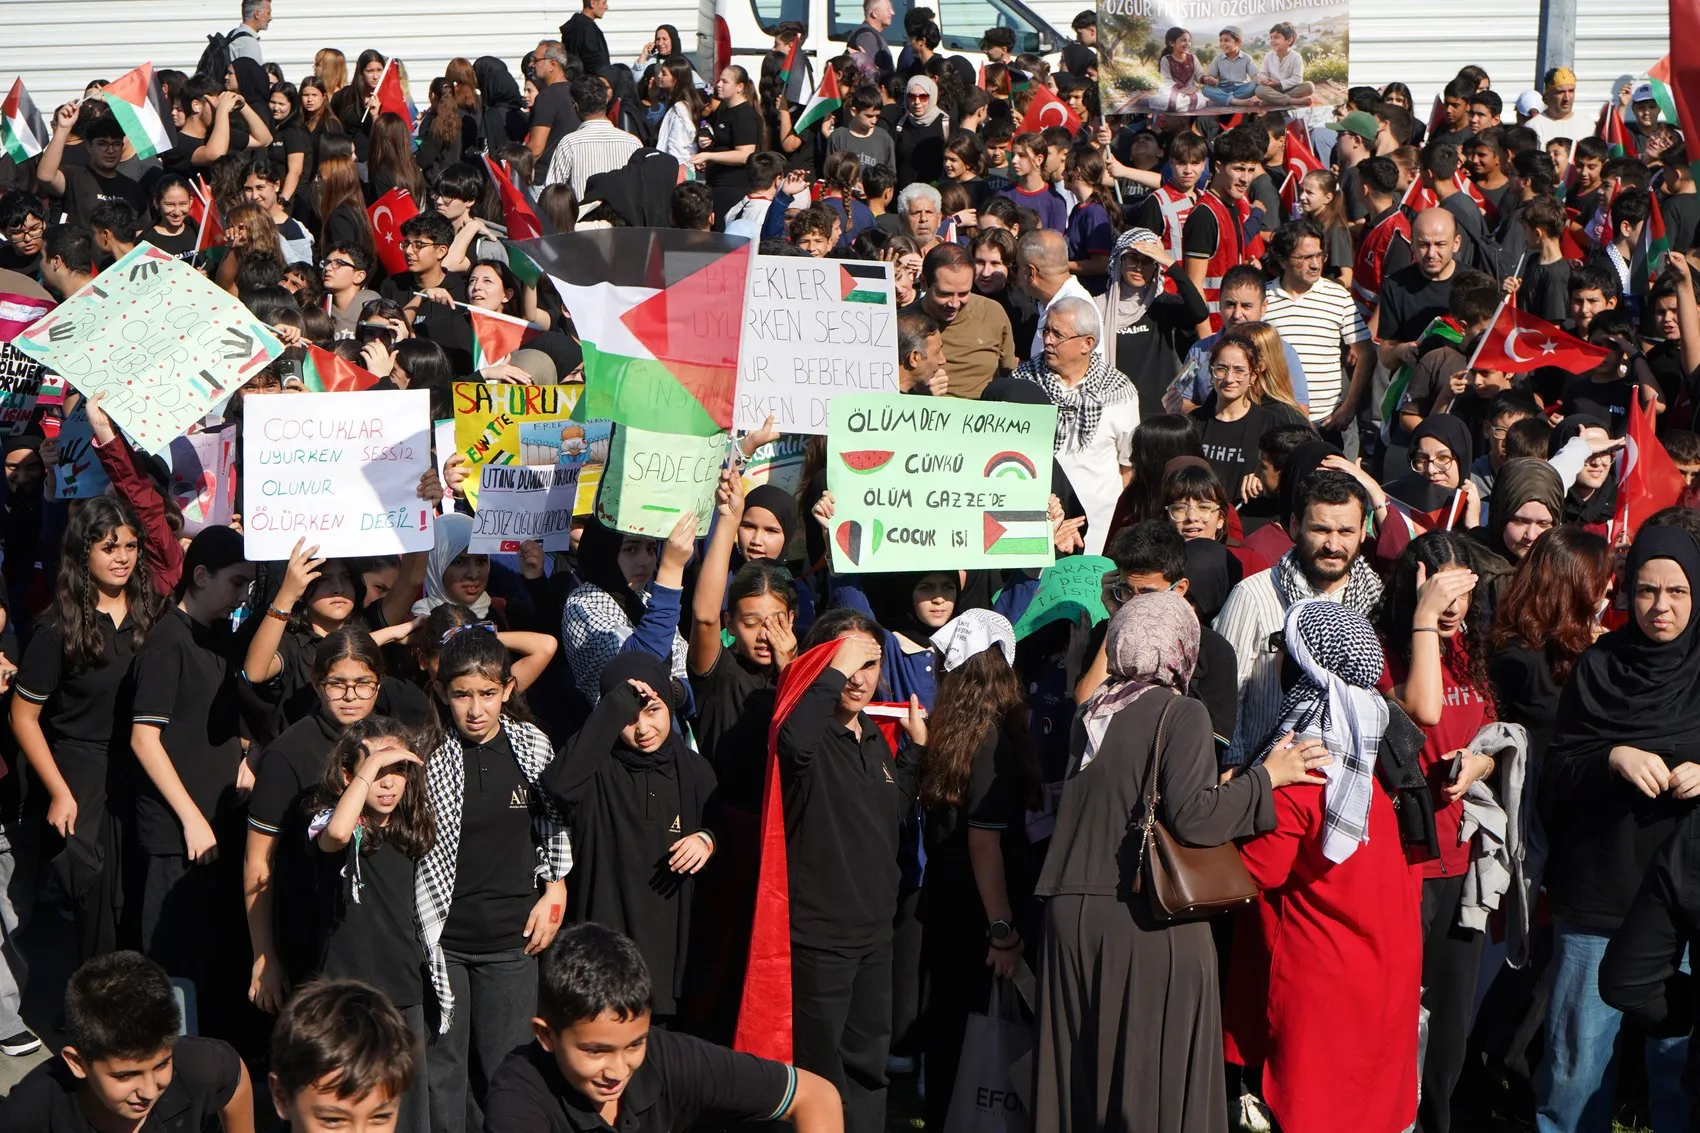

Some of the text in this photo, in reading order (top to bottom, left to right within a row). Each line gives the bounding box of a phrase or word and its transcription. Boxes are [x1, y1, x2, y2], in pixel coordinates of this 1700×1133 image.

[814, 307, 893, 347] SESSİZ
[794, 358, 898, 391] BEBEKLER
[454, 382, 577, 416] SAHURUN
[847, 404, 1031, 434] ÖLÜMDEN KORKMA
[259, 449, 344, 465] UYURKEN
[628, 452, 717, 484] SADECE
[262, 479, 336, 497] OLUNUR
[863, 484, 913, 508] ÖLÜM
[251, 505, 345, 531] ÖLÜRKEN
[976, 1086, 1024, 1113] EFO
